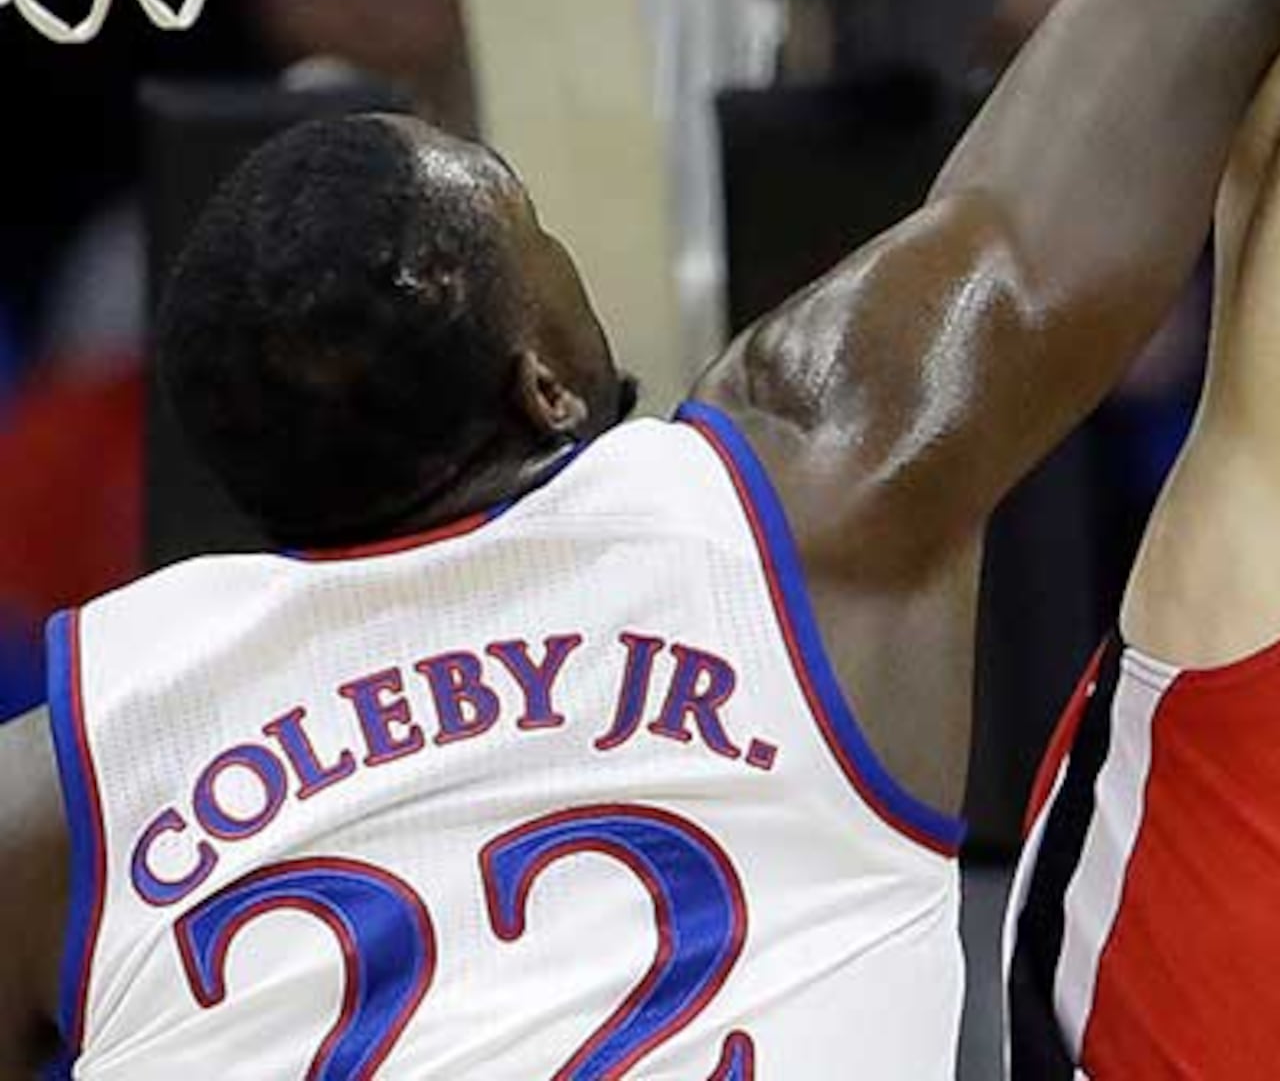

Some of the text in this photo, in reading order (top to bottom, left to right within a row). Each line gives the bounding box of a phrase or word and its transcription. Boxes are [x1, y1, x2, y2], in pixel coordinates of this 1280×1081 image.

[130, 632, 778, 907] COLEBY JR.
[174, 802, 756, 1081] 22
